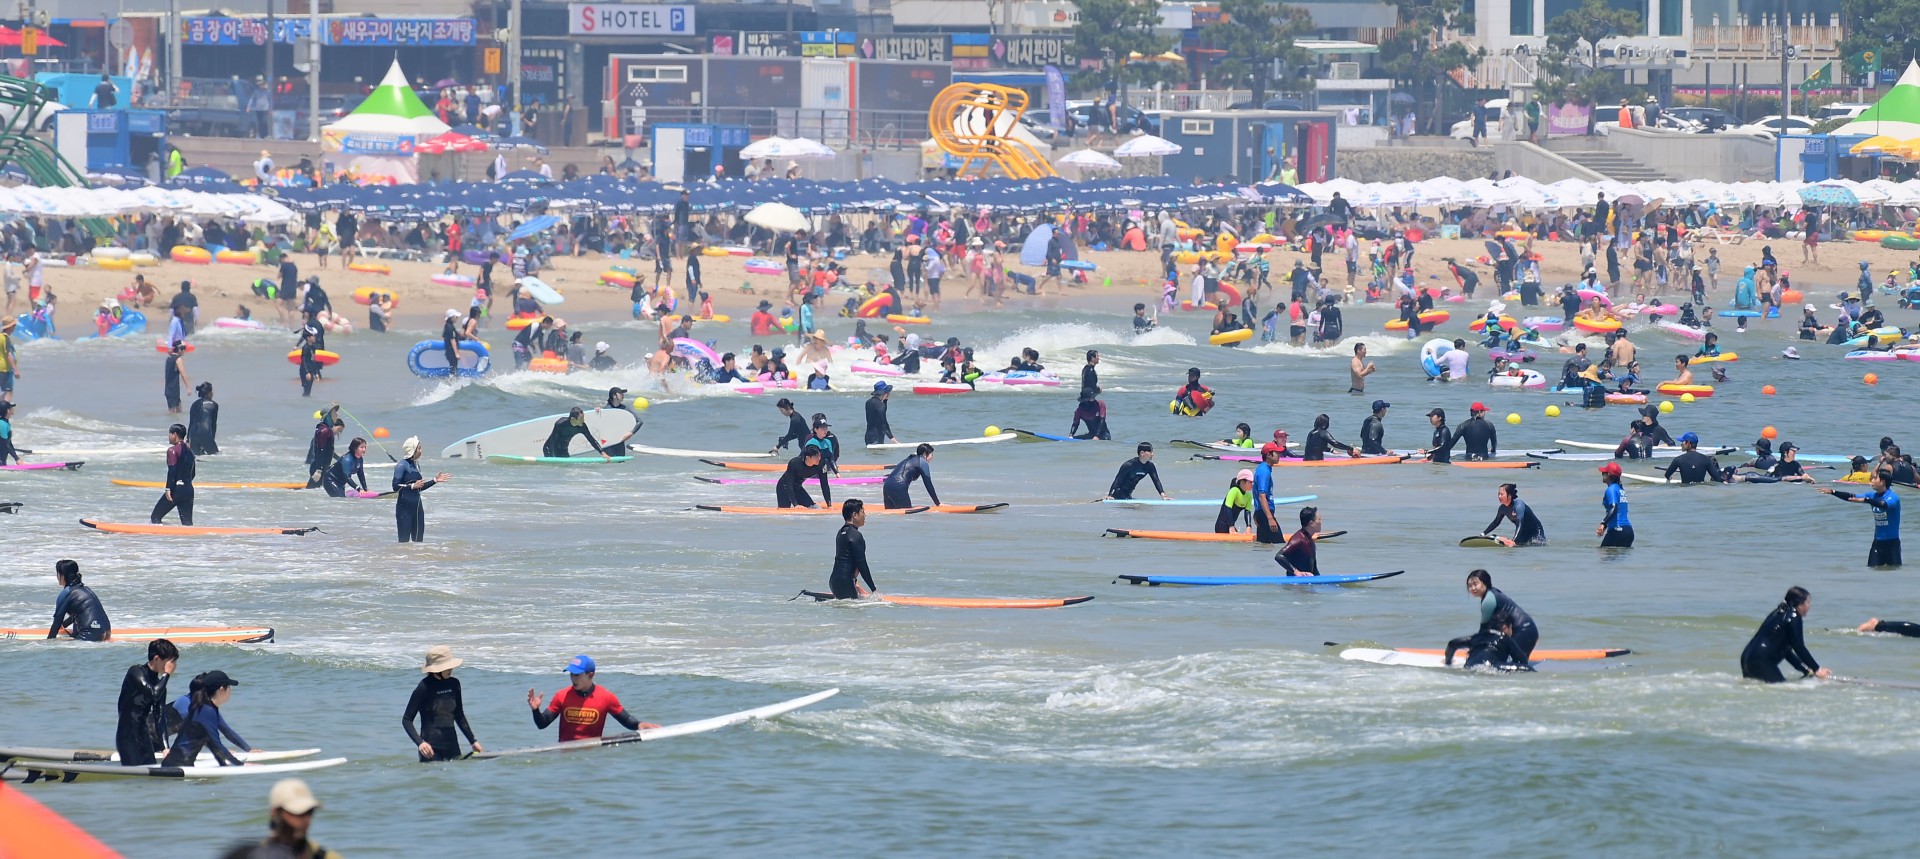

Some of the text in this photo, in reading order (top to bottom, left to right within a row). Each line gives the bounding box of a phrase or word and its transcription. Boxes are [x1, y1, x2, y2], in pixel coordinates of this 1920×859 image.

[582, 6, 684, 31] S HOTEL P
[395, 20, 432, 42] 산낙지
[434, 20, 473, 43] 조개탕
[875, 38, 944, 60] 비치편의점
